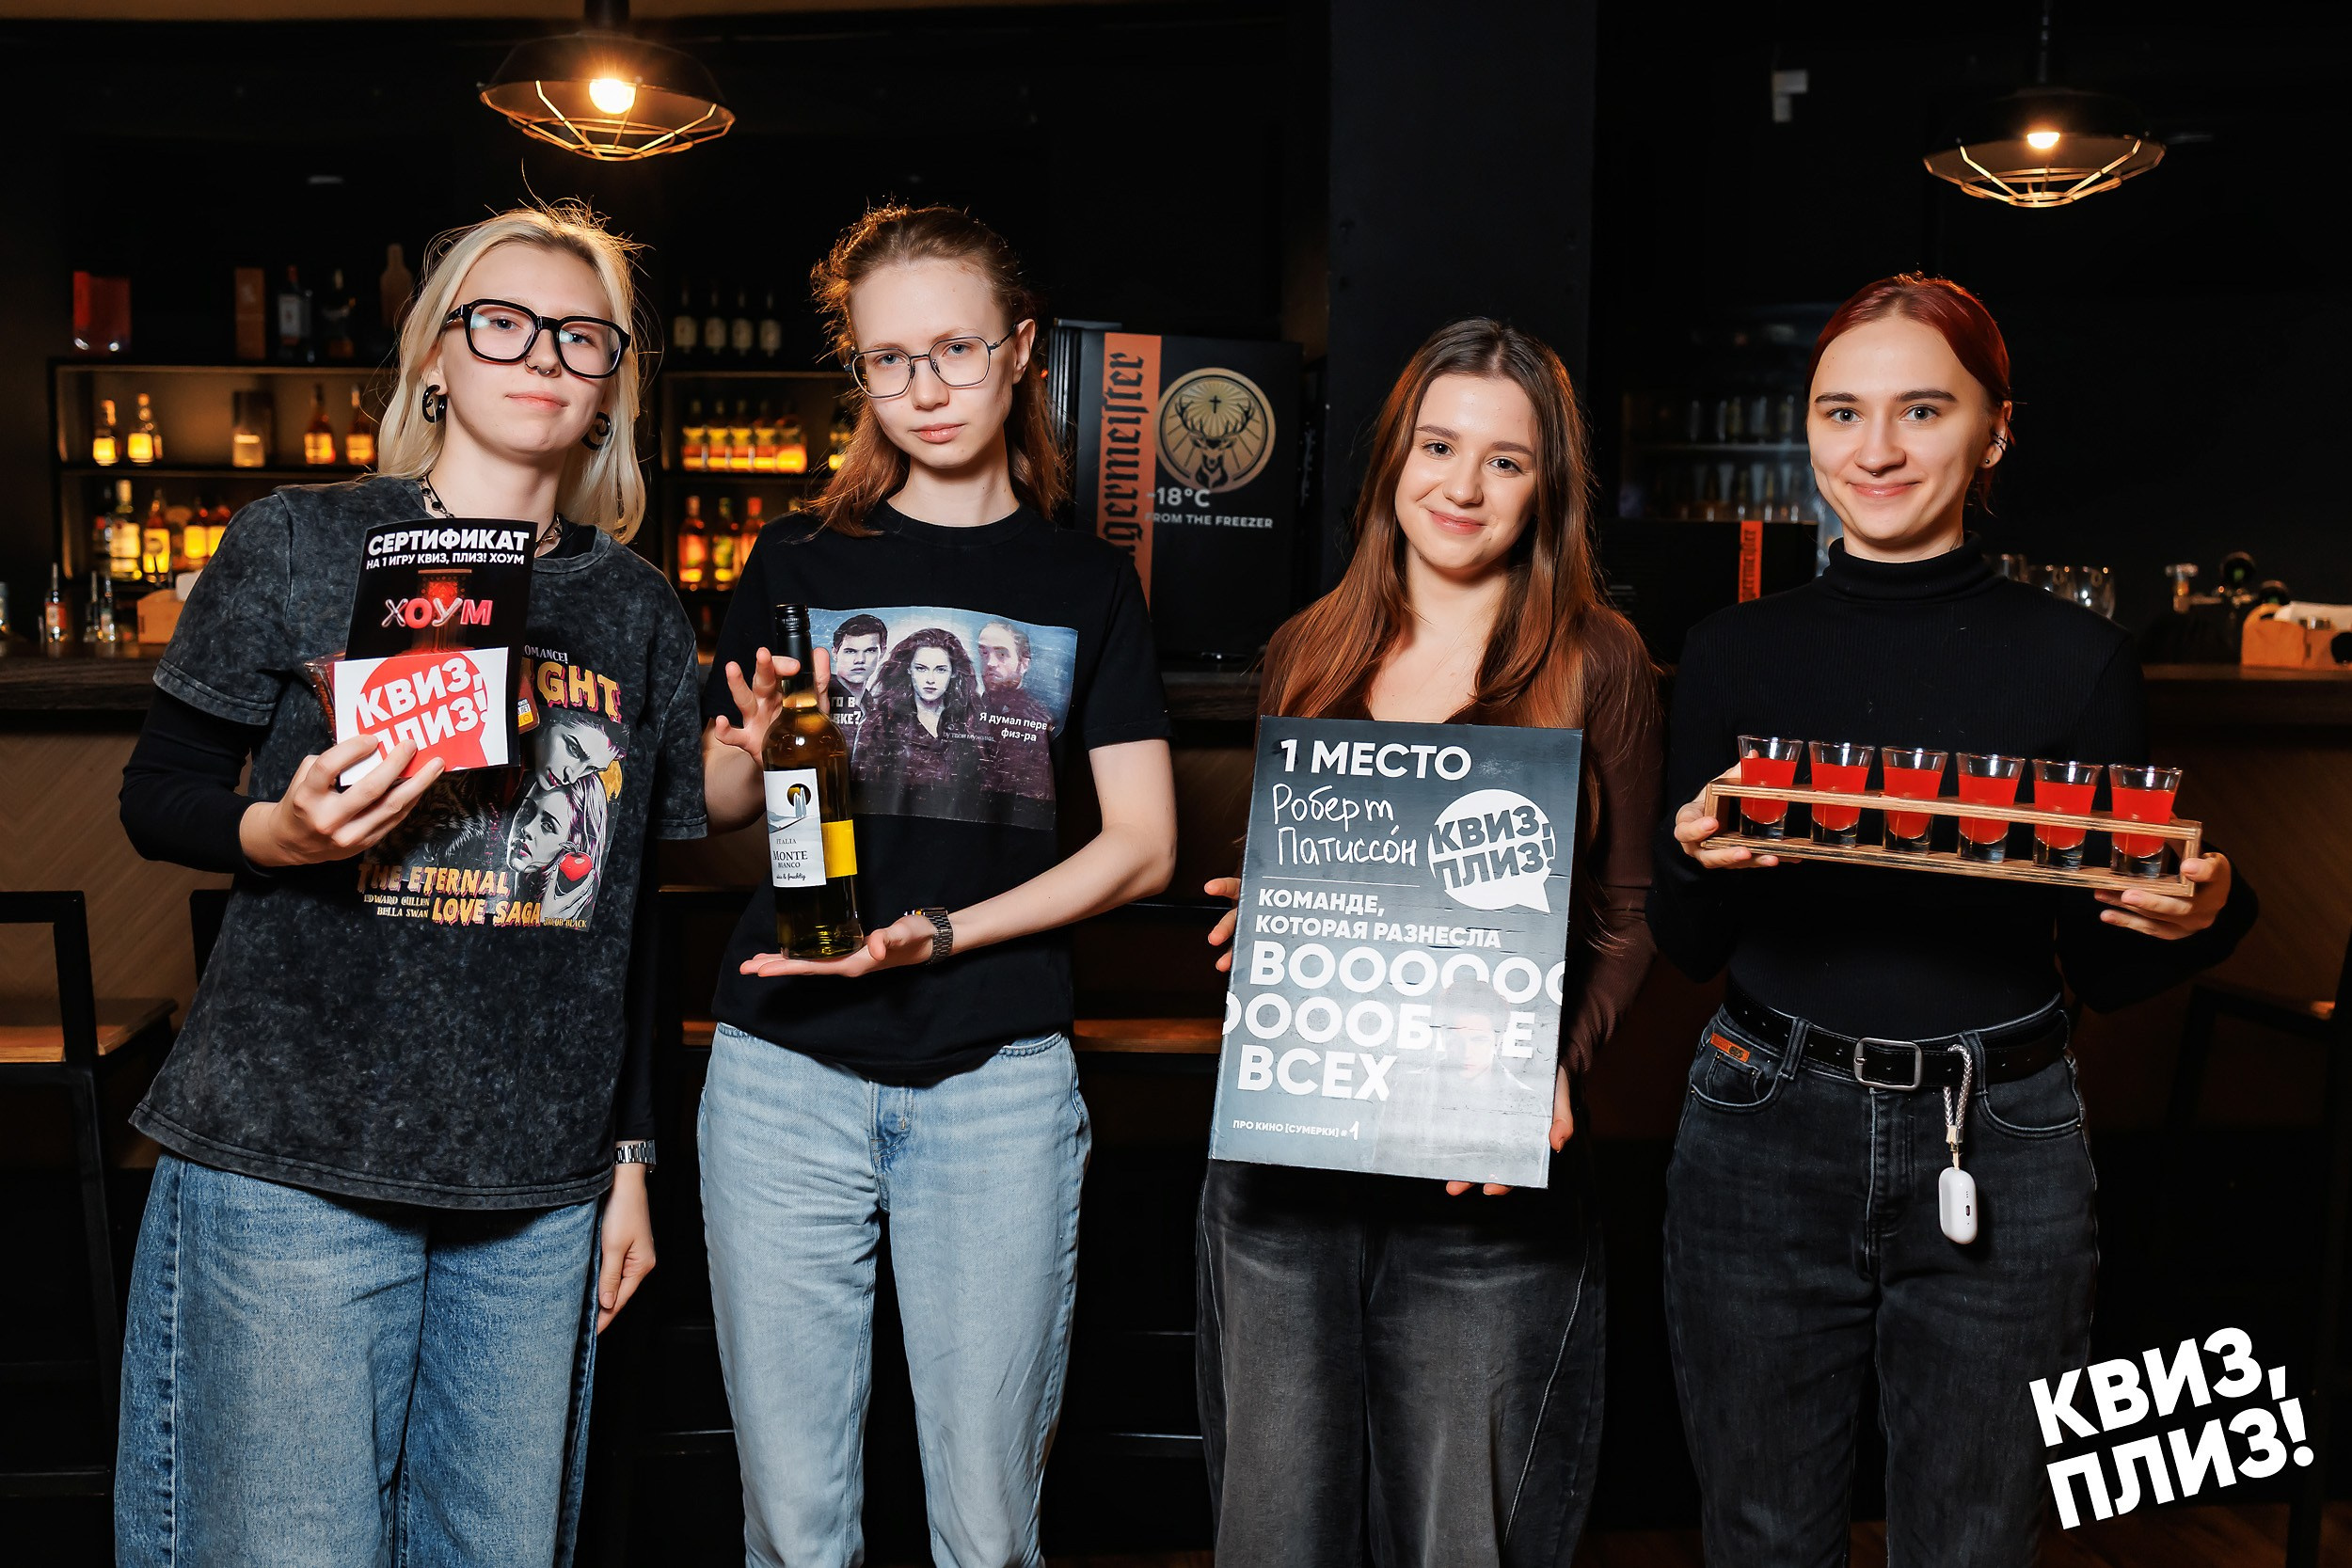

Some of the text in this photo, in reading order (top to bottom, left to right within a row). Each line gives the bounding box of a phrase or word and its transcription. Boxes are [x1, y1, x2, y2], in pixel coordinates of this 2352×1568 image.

[1144, 513, 1273, 529] FROM THE FREEZER
[368, 529, 530, 556] СЕРТИФИКАТ
[366, 552, 525, 570] НА 1 ИГРУ КВИЗ, ПЛИЗ! ХОУМ
[381, 597, 494, 629] ХОУМ
[357, 657, 484, 729] КВИЗ,
[978, 712, 988, 721] Я
[989, 714, 1022, 725] думал
[1000, 727, 1038, 742] физ-ра
[1280, 738, 1472, 781] 1 МЕСТО
[1272, 783, 1394, 832] Роберт
[1431, 805, 1551, 855] КВИЗ,
[772, 850, 808, 861] MONTE
[1433, 838, 1555, 890] ПЛИЗ!
[358, 864, 511, 897] THE ETERNAL
[363, 894, 430, 907] EDWARD CULLEN
[376, 906, 429, 918] BELLA SWAN
[432, 897, 542, 927] LOVE SAGA
[1258, 888, 1385, 917] КОМАНДЕ,
[543, 917, 587, 928] JACOB BLACK
[1255, 914, 1502, 949] КОТОРАЯ РАЗНЕСЛА
[1237, 1044, 1399, 1101] ВСЕХ
[1232, 1119, 1254, 1130] ПРО
[1255, 1121, 1284, 1132] КИНО
[1284, 1123, 1340, 1138] [СУМЕРКИ]
